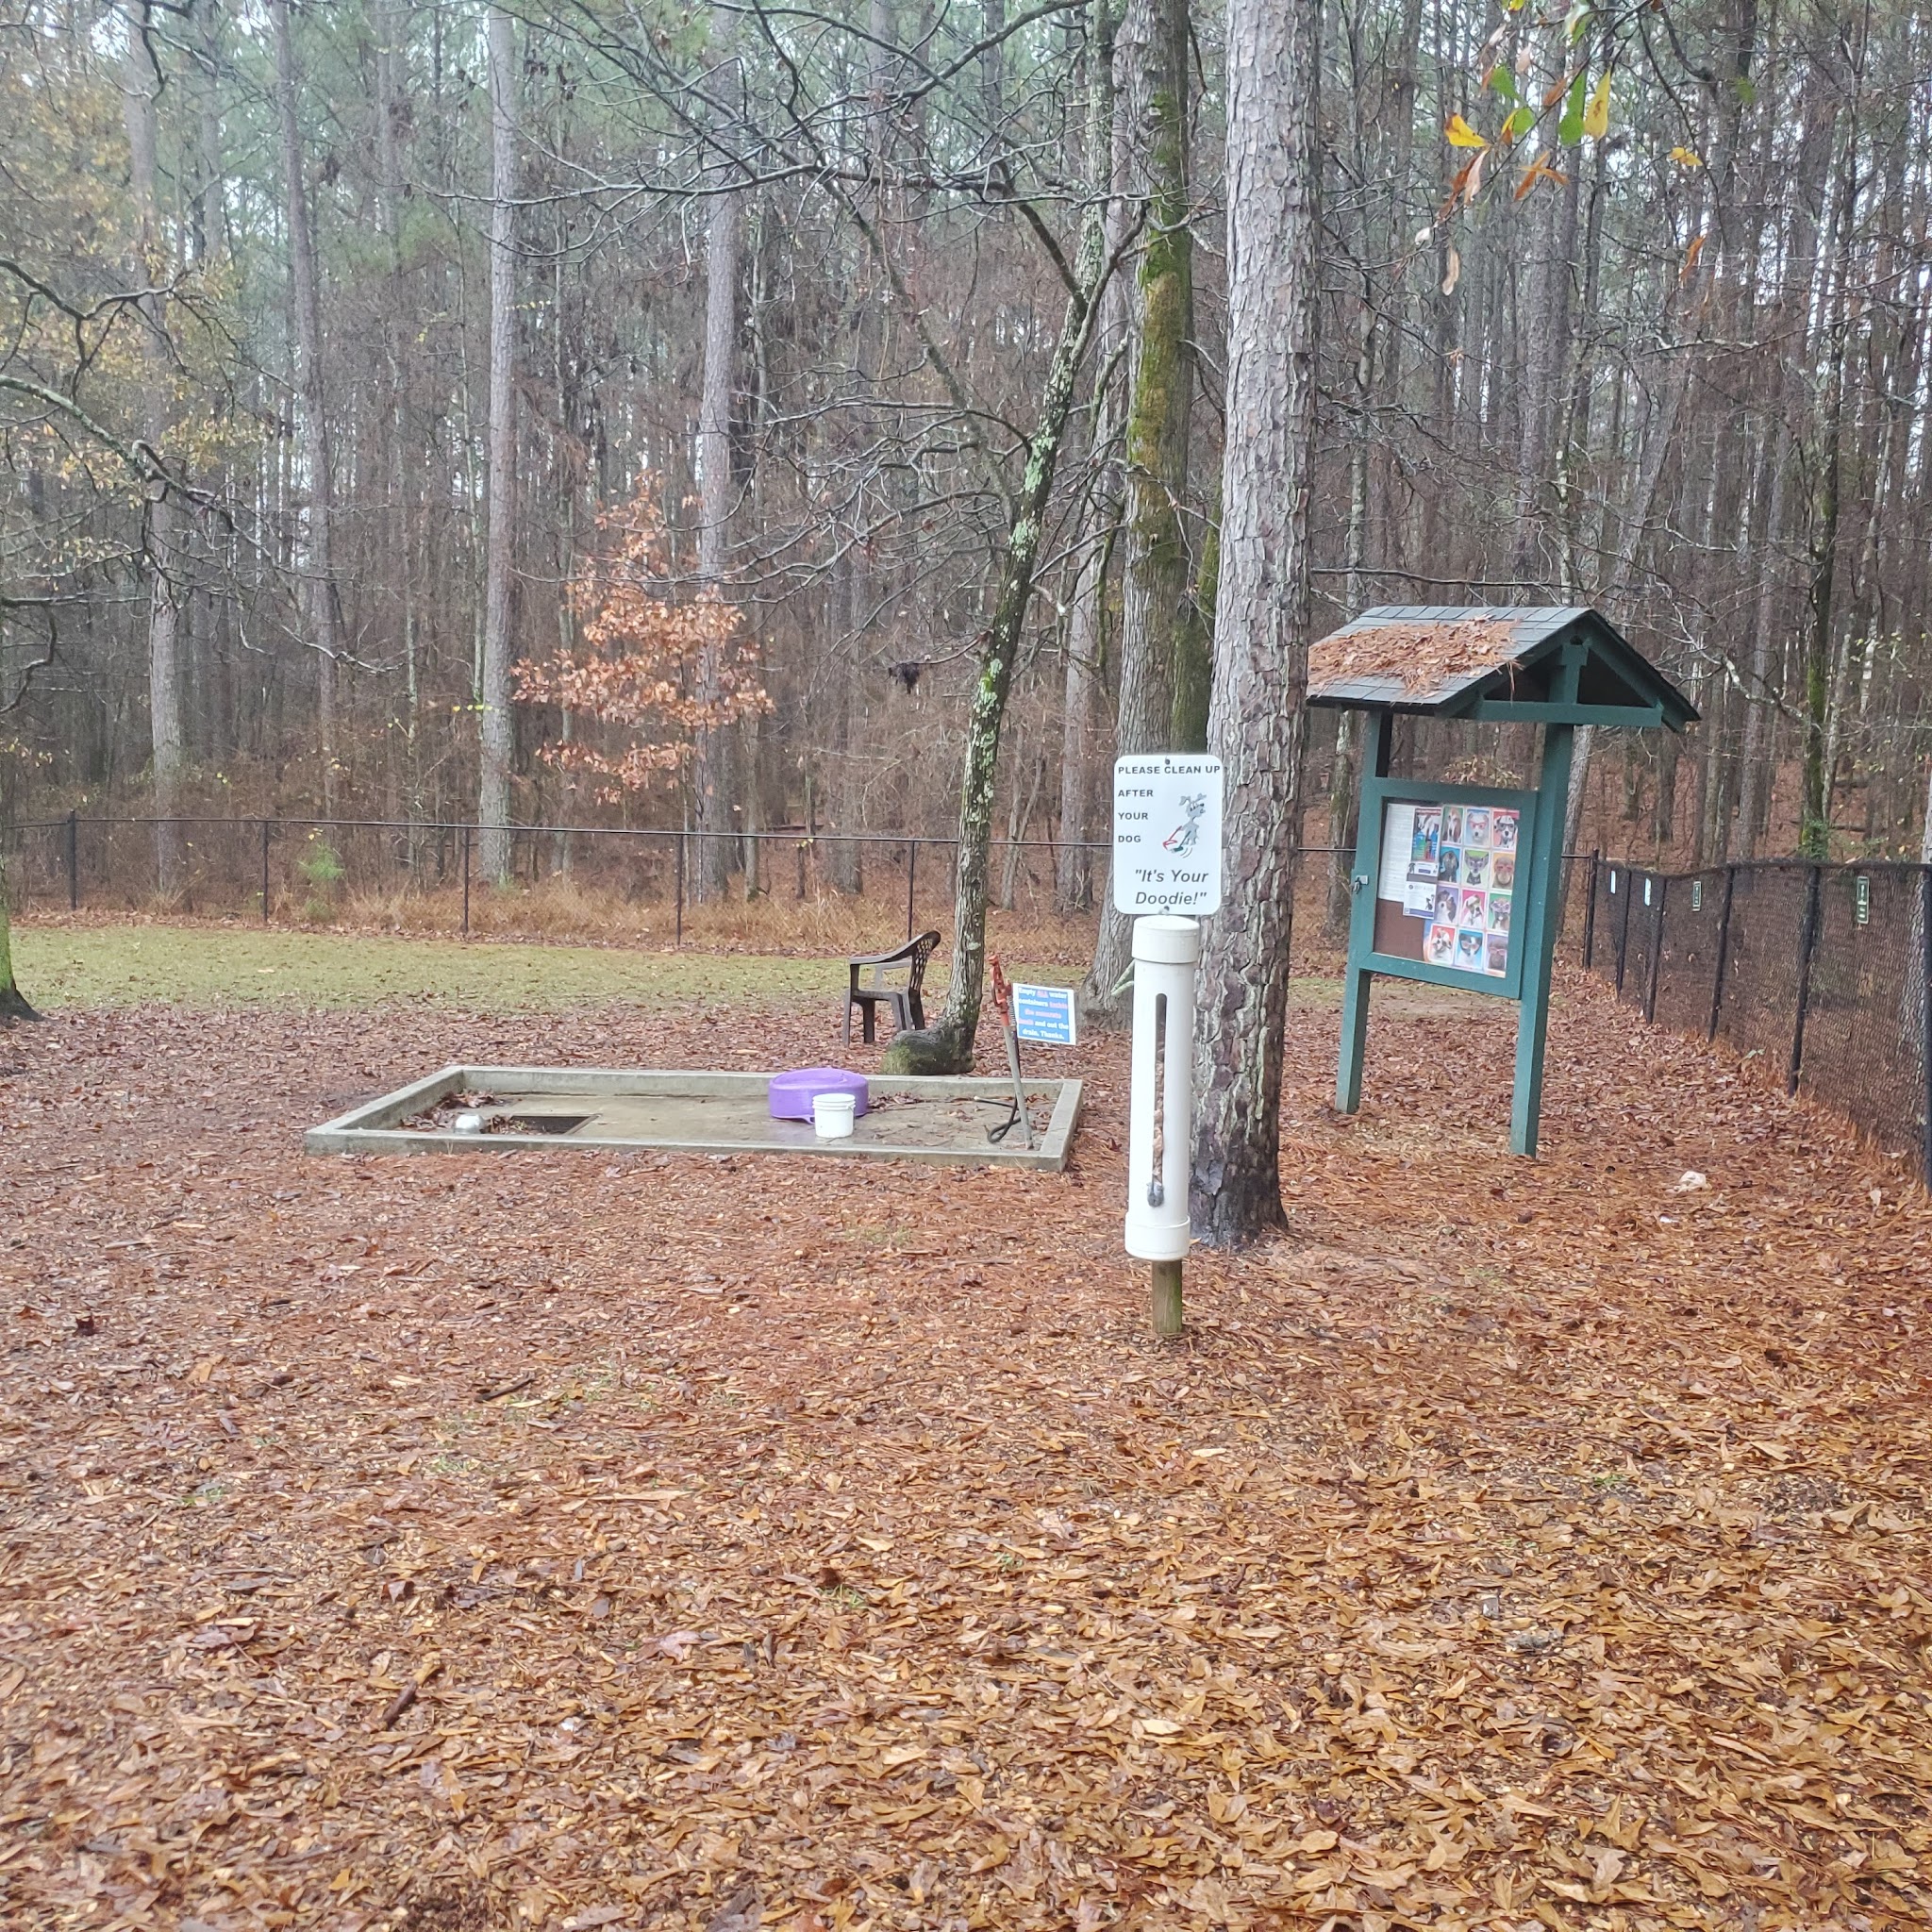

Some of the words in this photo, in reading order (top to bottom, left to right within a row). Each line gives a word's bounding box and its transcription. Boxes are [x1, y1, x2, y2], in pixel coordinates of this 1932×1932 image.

[1118, 766, 1160, 774] PLEASE
[1164, 765, 1201, 774] CLEAN
[1206, 765, 1221, 774] UP
[1118, 812, 1148, 821] YOUR
[1118, 835, 1141, 843] DOG
[1135, 869, 1165, 883] "It's
[1171, 869, 1208, 883] Your
[1135, 891, 1208, 905] Doodie!"
[1019, 988, 1036, 996] Empty
